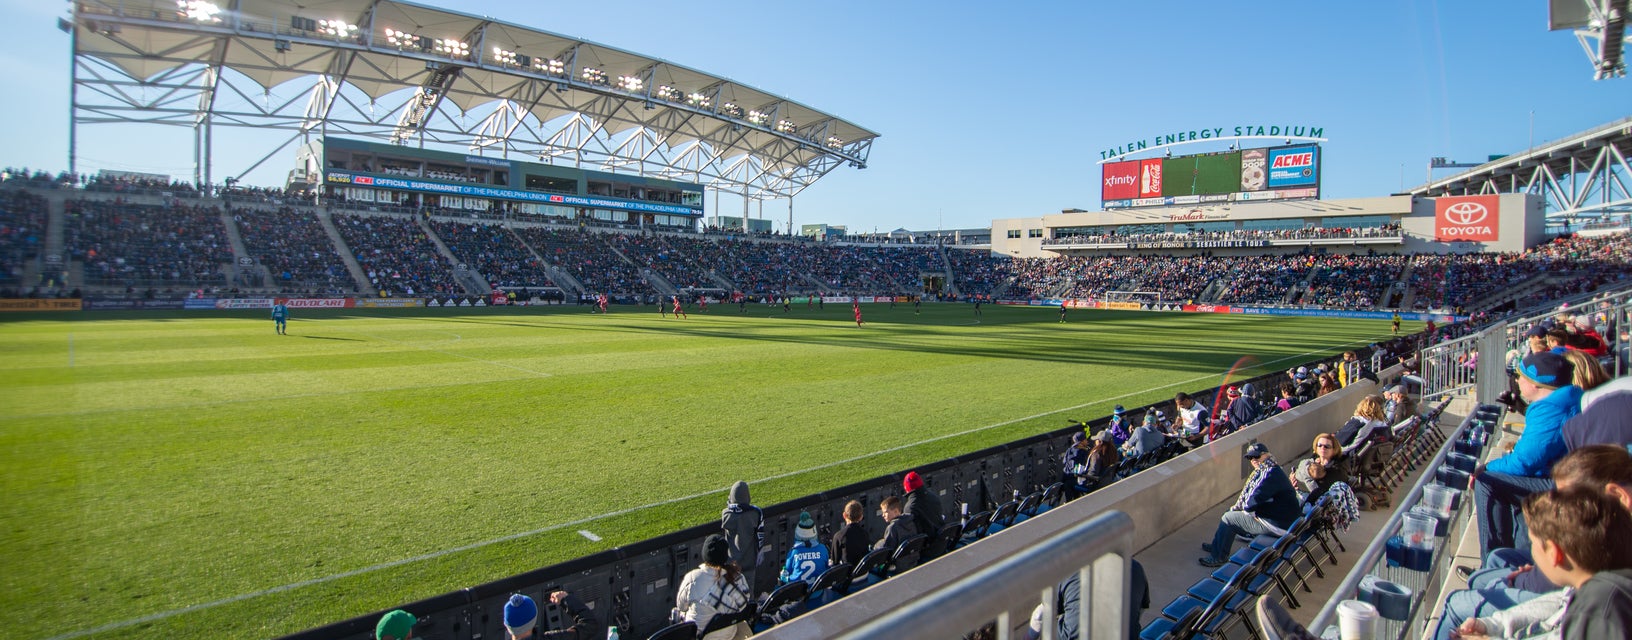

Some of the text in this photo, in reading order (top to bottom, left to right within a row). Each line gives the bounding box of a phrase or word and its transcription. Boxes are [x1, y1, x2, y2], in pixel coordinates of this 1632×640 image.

[1101, 125, 1324, 160] TALEN ENERGY STADIUM
[1273, 154, 1312, 168] ACME
[1105, 174, 1136, 187] xfinity
[1150, 163, 1161, 192] Coca-Cola
[376, 178, 409, 188] OFFICIAL
[411, 181, 463, 193] SUPERMARKET
[487, 189, 528, 199] PHILADELPHIA
[565, 196, 589, 205] OFFICIAL
[590, 198, 627, 208] SUPERMARKET
[645, 203, 675, 212] PHILADELPHIA
[1170, 210, 1205, 221] TruMark
[1440, 226, 1492, 236] TOYOTA
[287, 299, 344, 307] ADVOCARE
[794, 551, 821, 561] POWERS
[800, 560, 816, 584] 2
